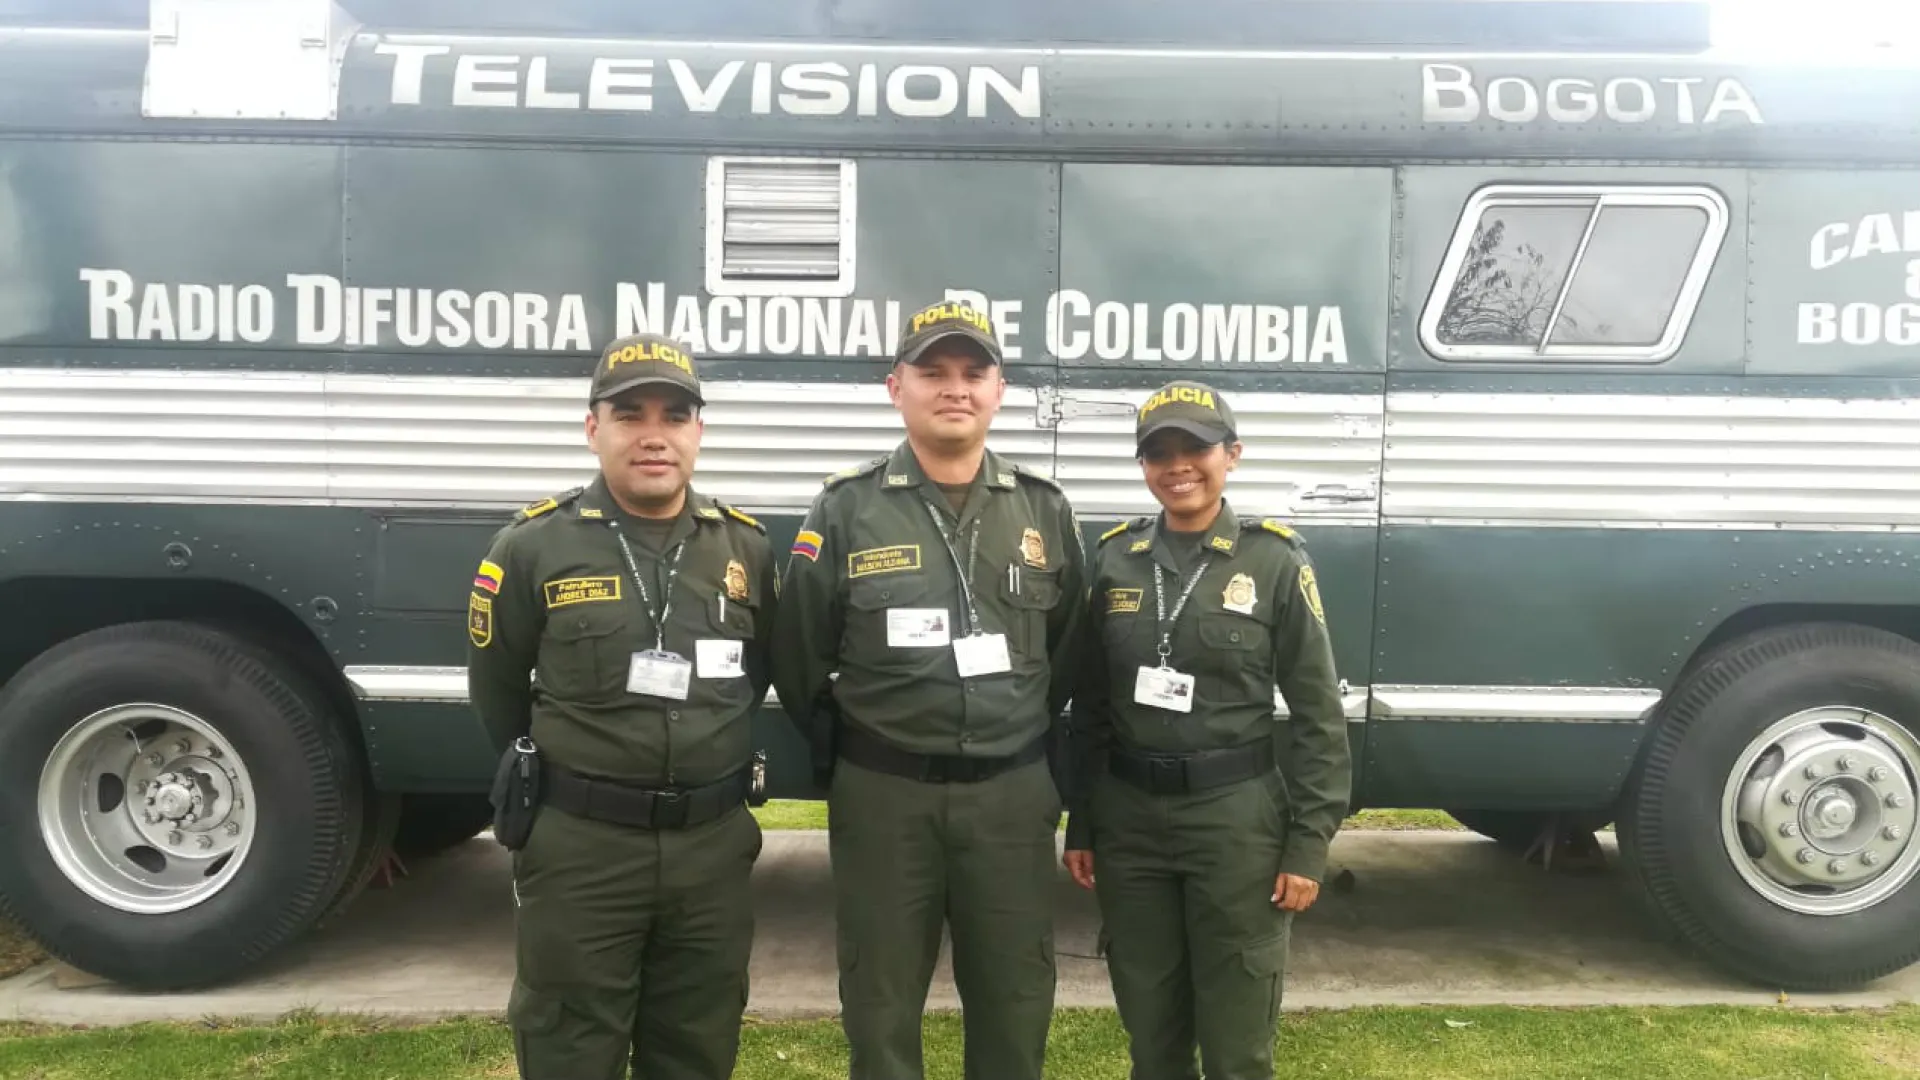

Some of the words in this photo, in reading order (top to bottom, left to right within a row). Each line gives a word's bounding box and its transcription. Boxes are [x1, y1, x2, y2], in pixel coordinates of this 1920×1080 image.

[374, 44, 1042, 118] TELEVISION
[1420, 62, 1764, 125] BOGOTA
[79, 268, 275, 343] RADIO
[286, 273, 592, 351] DIFUSORA
[1045, 289, 1349, 365] COLOMBIA
[912, 303, 991, 335] POLICIA
[608, 343, 692, 375] POLICIA
[1140, 387, 1215, 423] POLICIA
